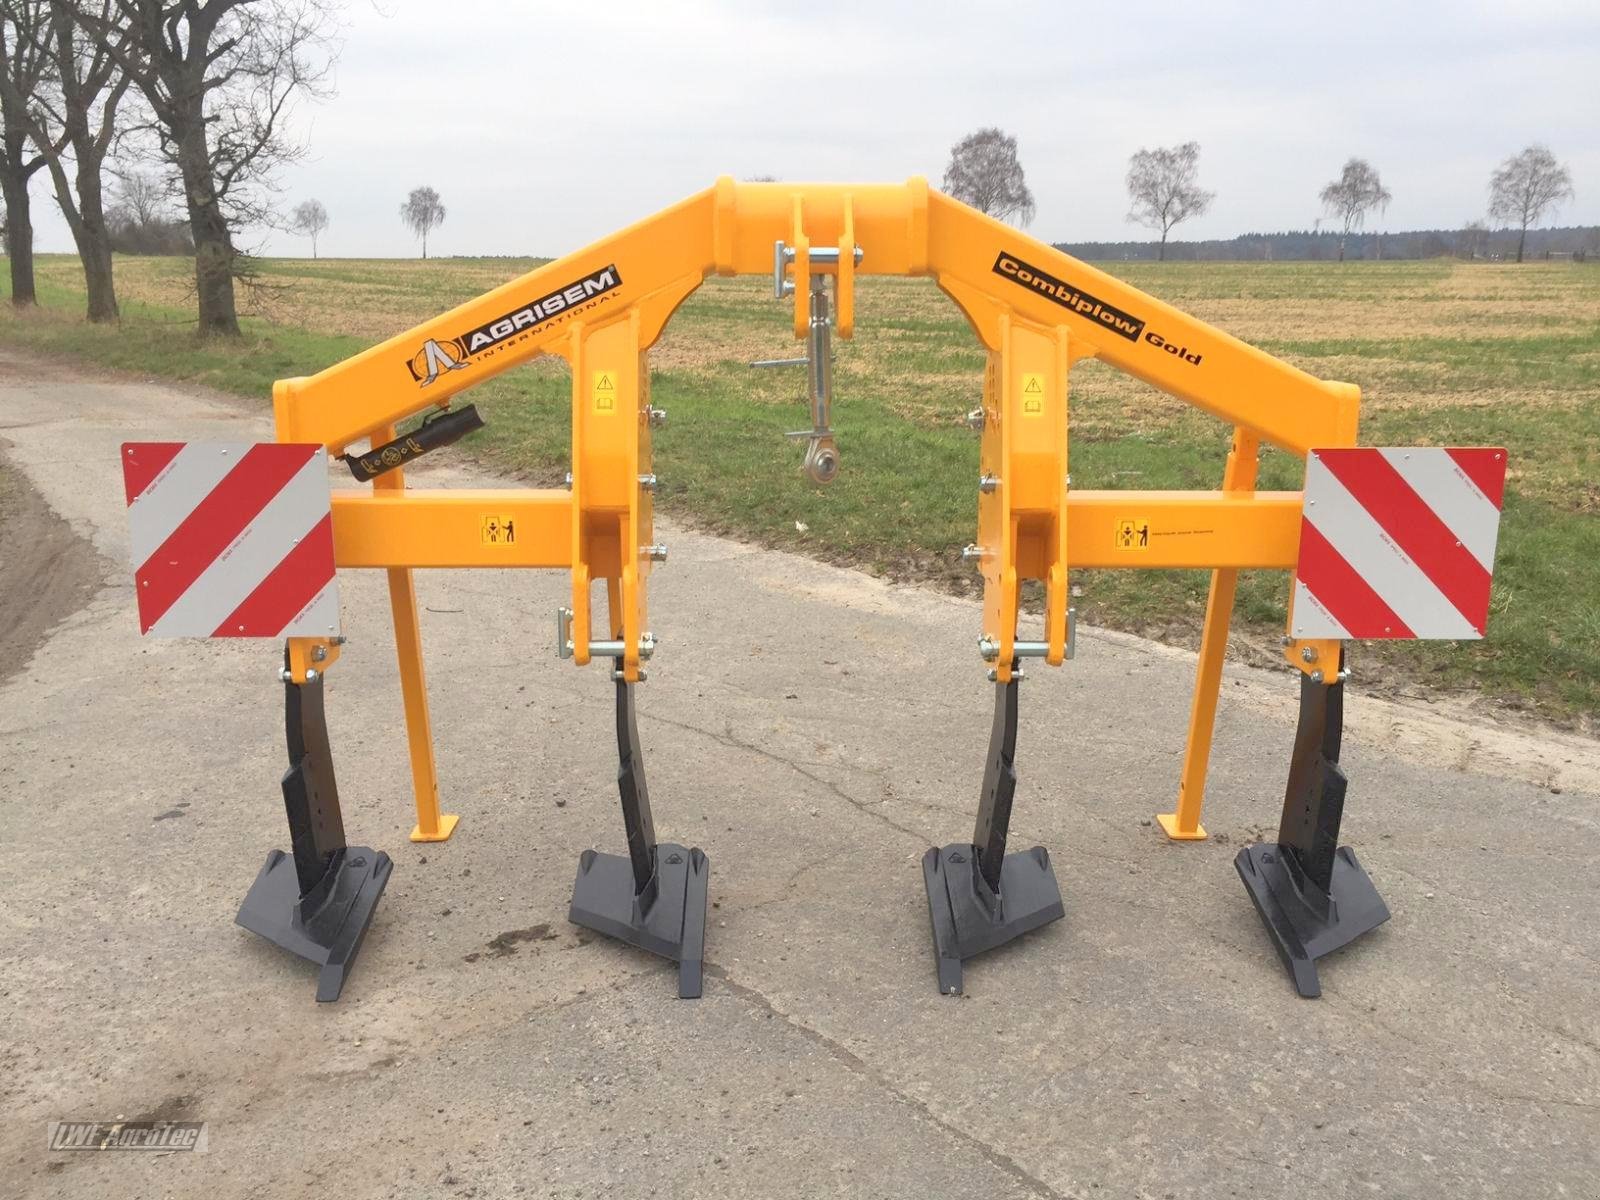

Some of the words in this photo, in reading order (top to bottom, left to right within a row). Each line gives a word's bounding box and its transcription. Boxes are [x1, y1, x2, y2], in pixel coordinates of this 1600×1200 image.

[469, 269, 615, 352] AGRISEM
[476, 291, 621, 362] INTERNATIONAL
[998, 257, 1137, 335] Combiplow
[1144, 331, 1203, 366] Gold
